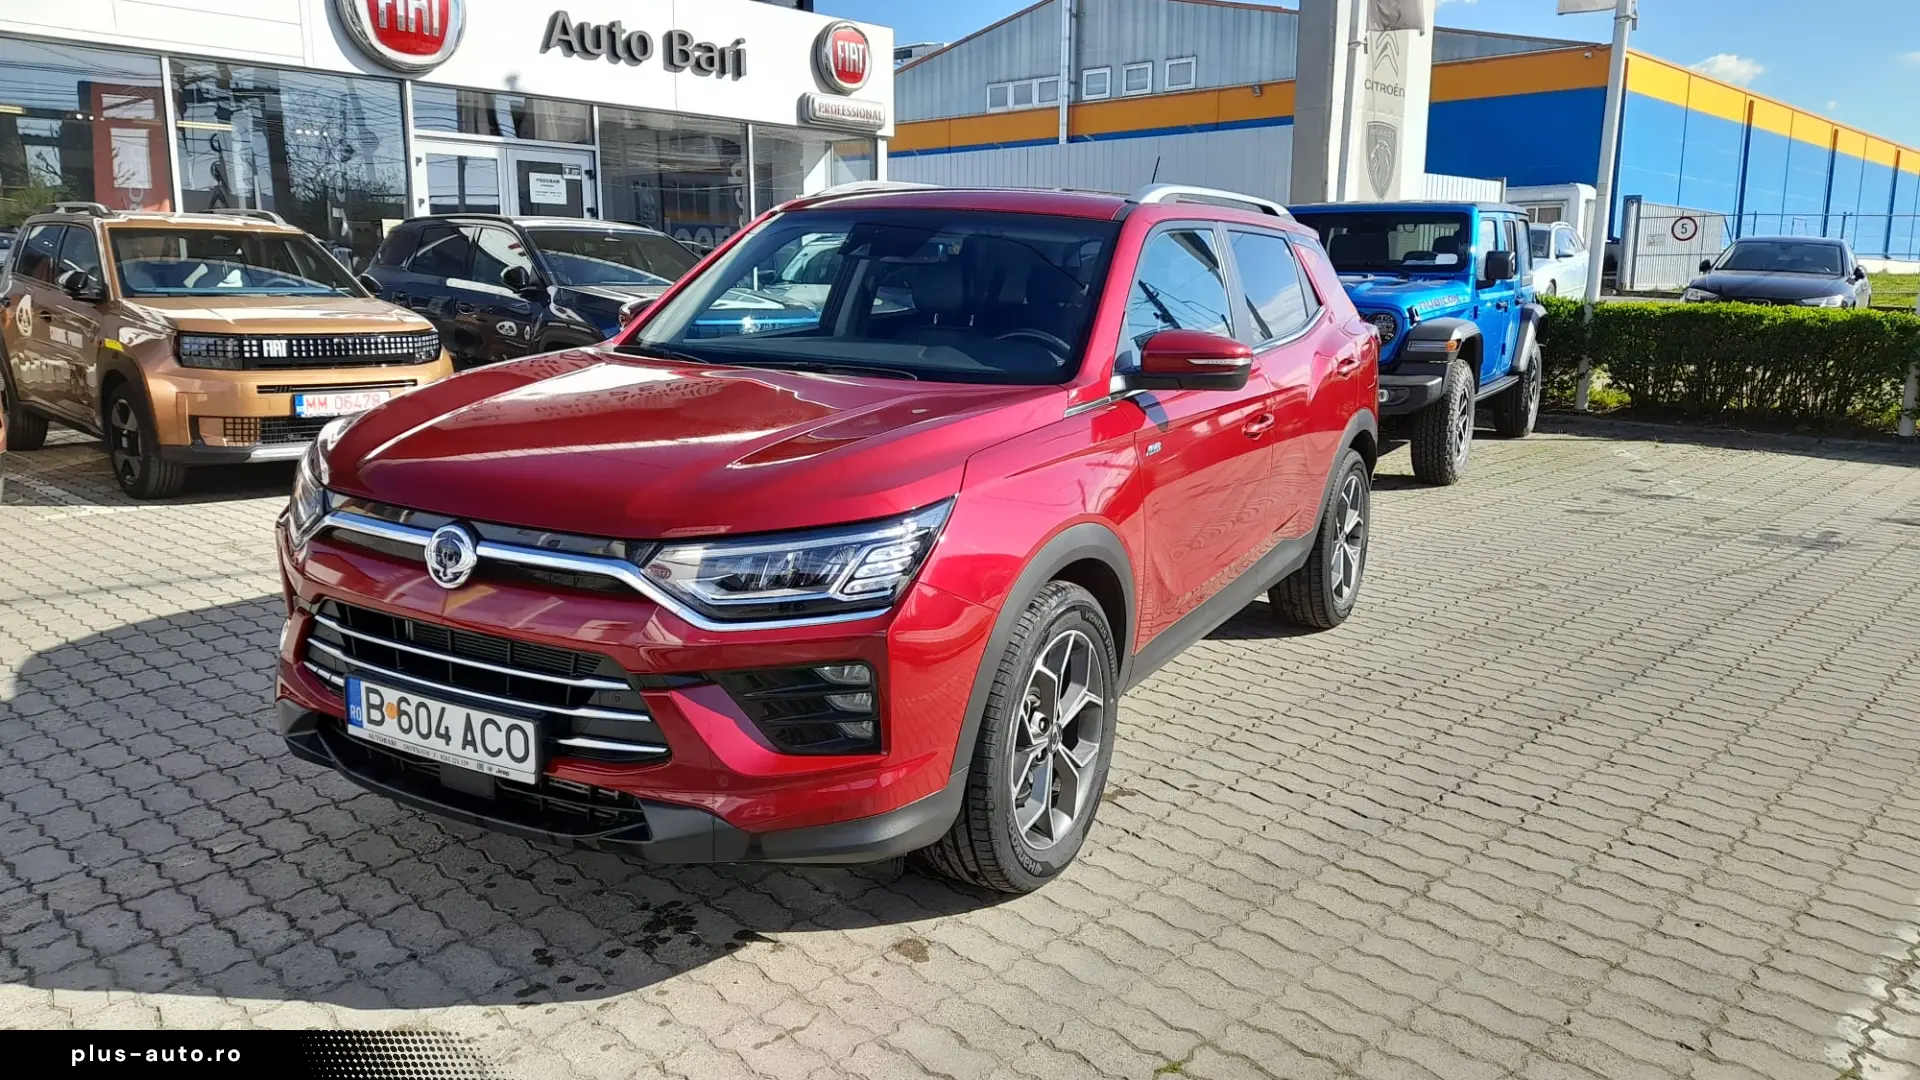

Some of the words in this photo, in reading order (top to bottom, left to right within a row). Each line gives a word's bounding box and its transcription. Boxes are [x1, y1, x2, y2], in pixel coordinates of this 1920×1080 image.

[541, 10, 654, 66] Auto
[837, 40, 865, 73] FIAT
[818, 102, 882, 121] PROFESSIONAL
[1680, 223, 1688, 235] 5
[1419, 293, 1460, 310] RUBICON
[262, 340, 288, 357] FIAT
[305, 396, 327, 410] MM
[334, 394, 380, 410] 06478
[350, 704, 362, 721] RO
[365, 686, 385, 726] B
[396, 696, 451, 746] 604
[461, 712, 530, 763] ACO
